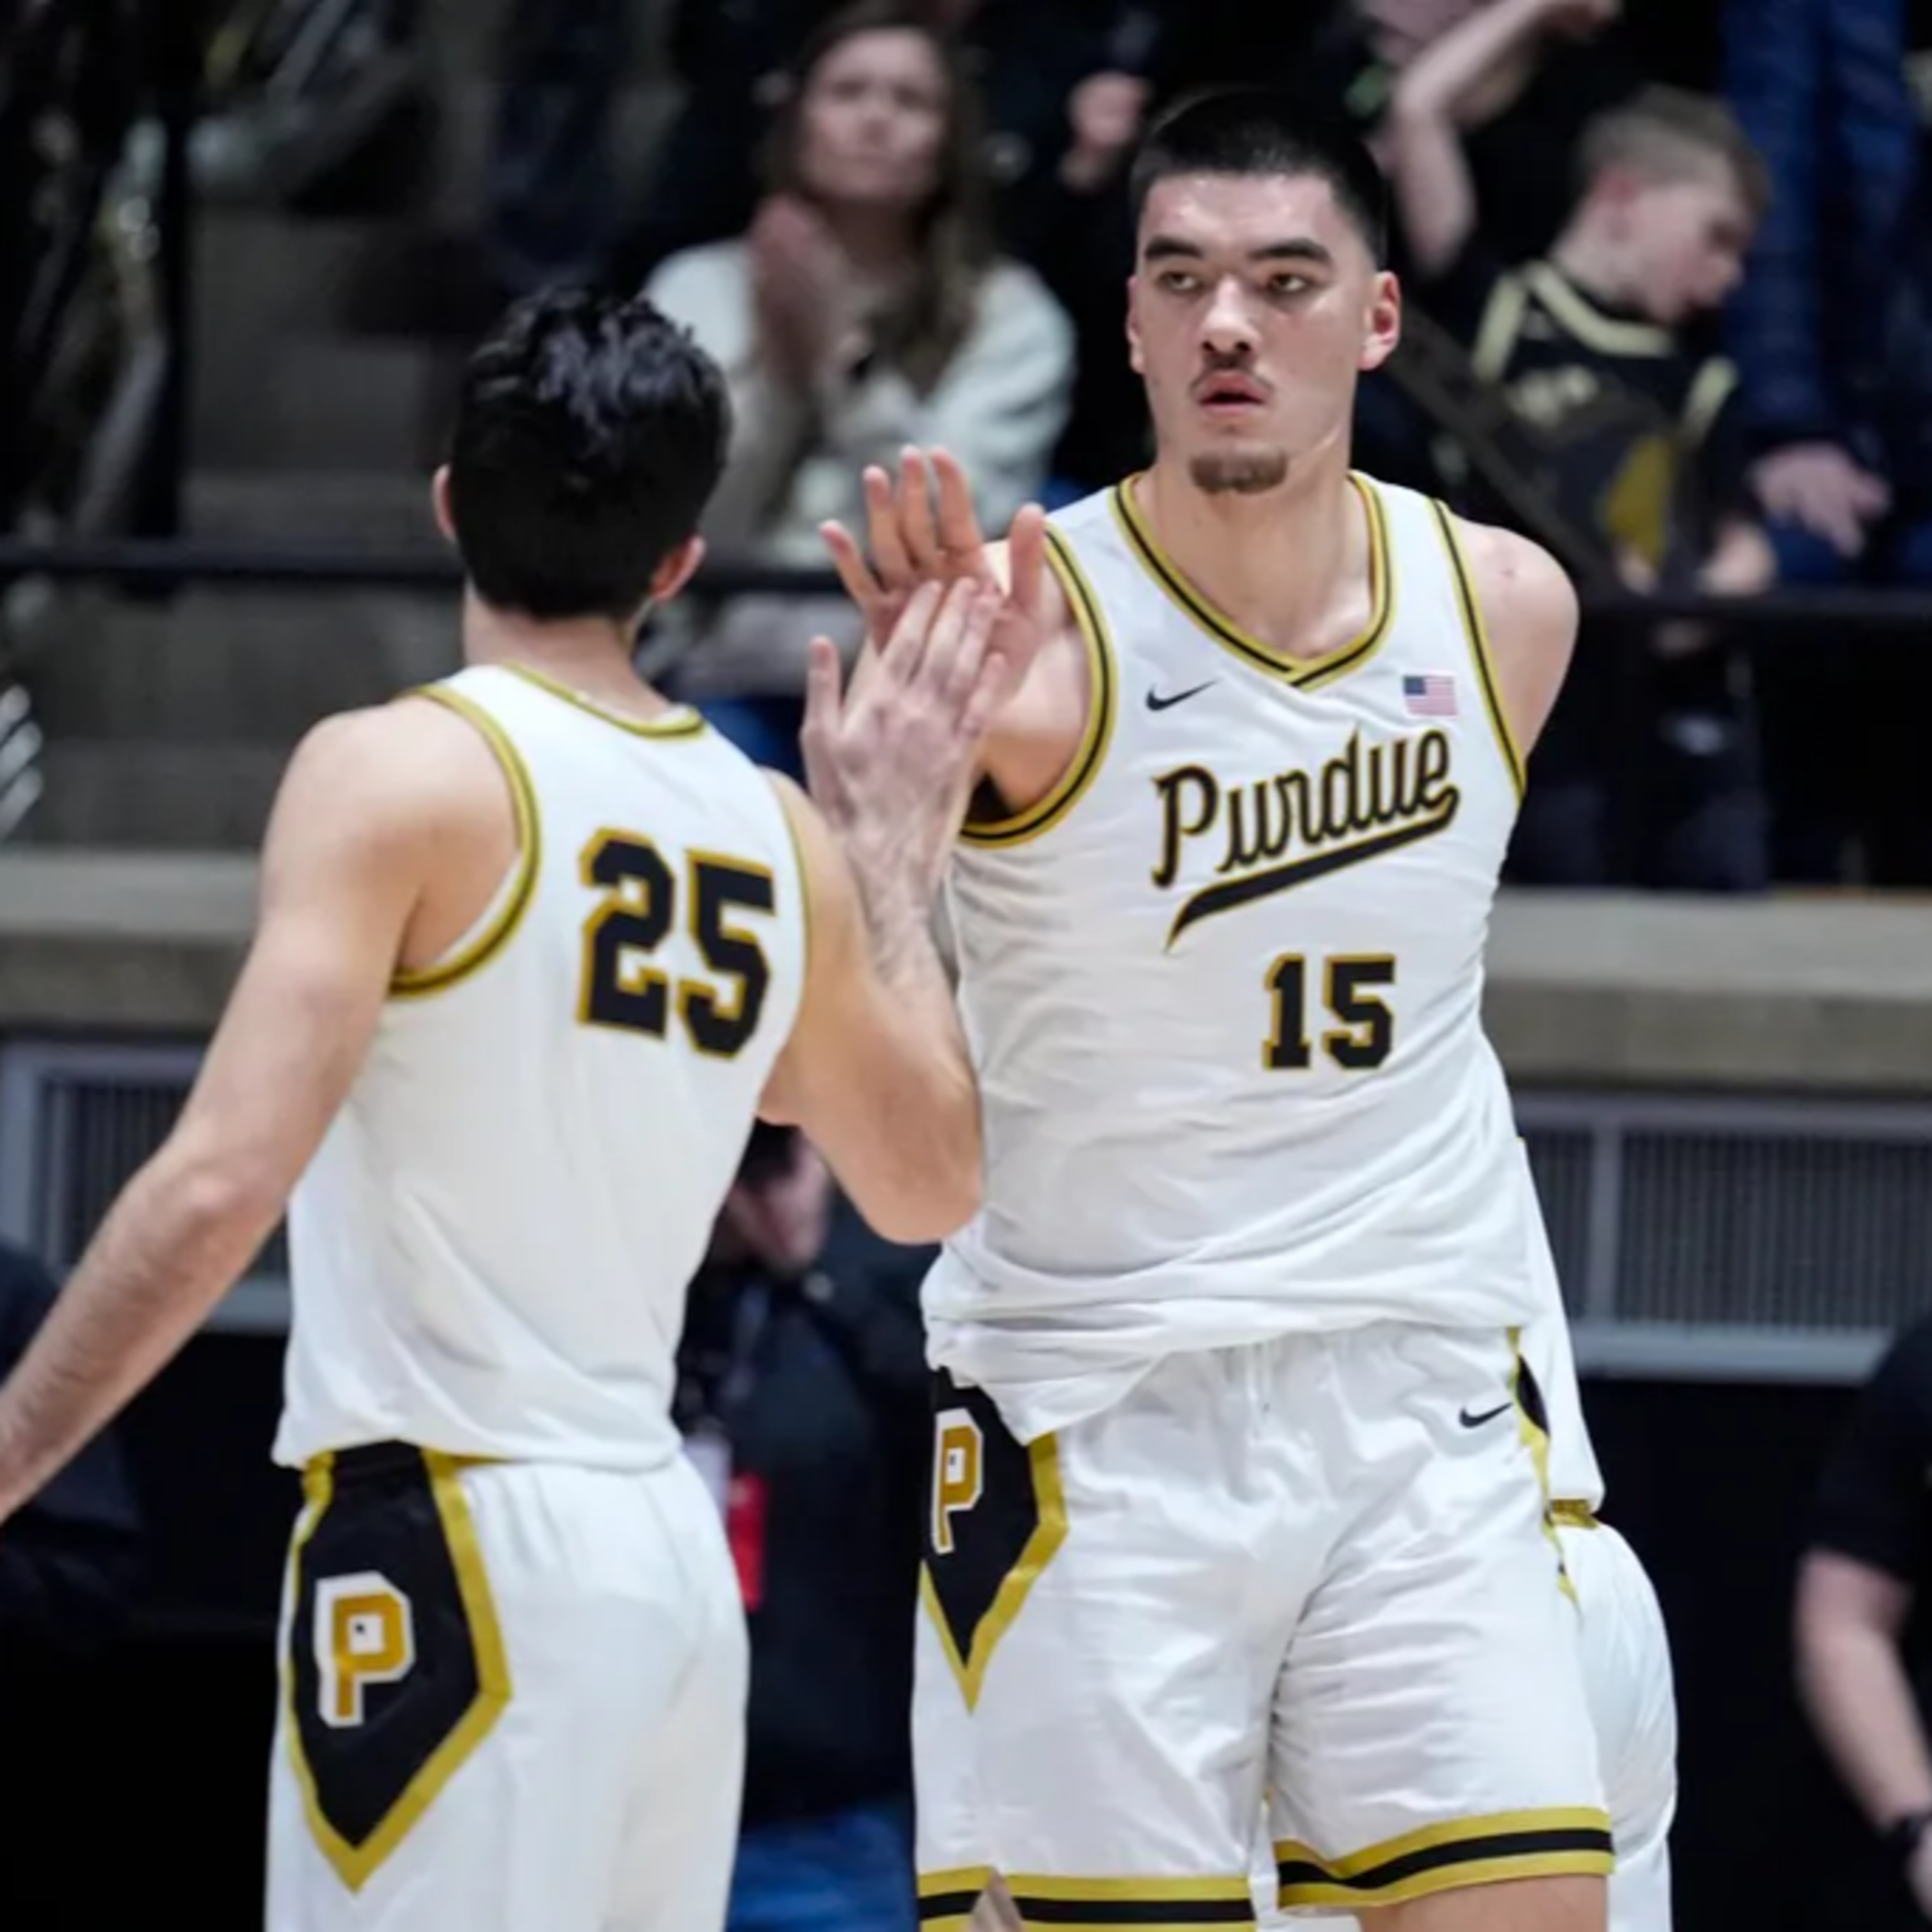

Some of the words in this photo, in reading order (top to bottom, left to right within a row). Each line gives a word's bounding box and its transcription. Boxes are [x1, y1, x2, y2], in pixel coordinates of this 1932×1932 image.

[1151, 723, 1461, 890] Purdue
[576, 826, 777, 1061] 25
[1262, 952, 1397, 1071] 15
[931, 1406, 985, 1555] P
[312, 1569, 417, 1730] P
